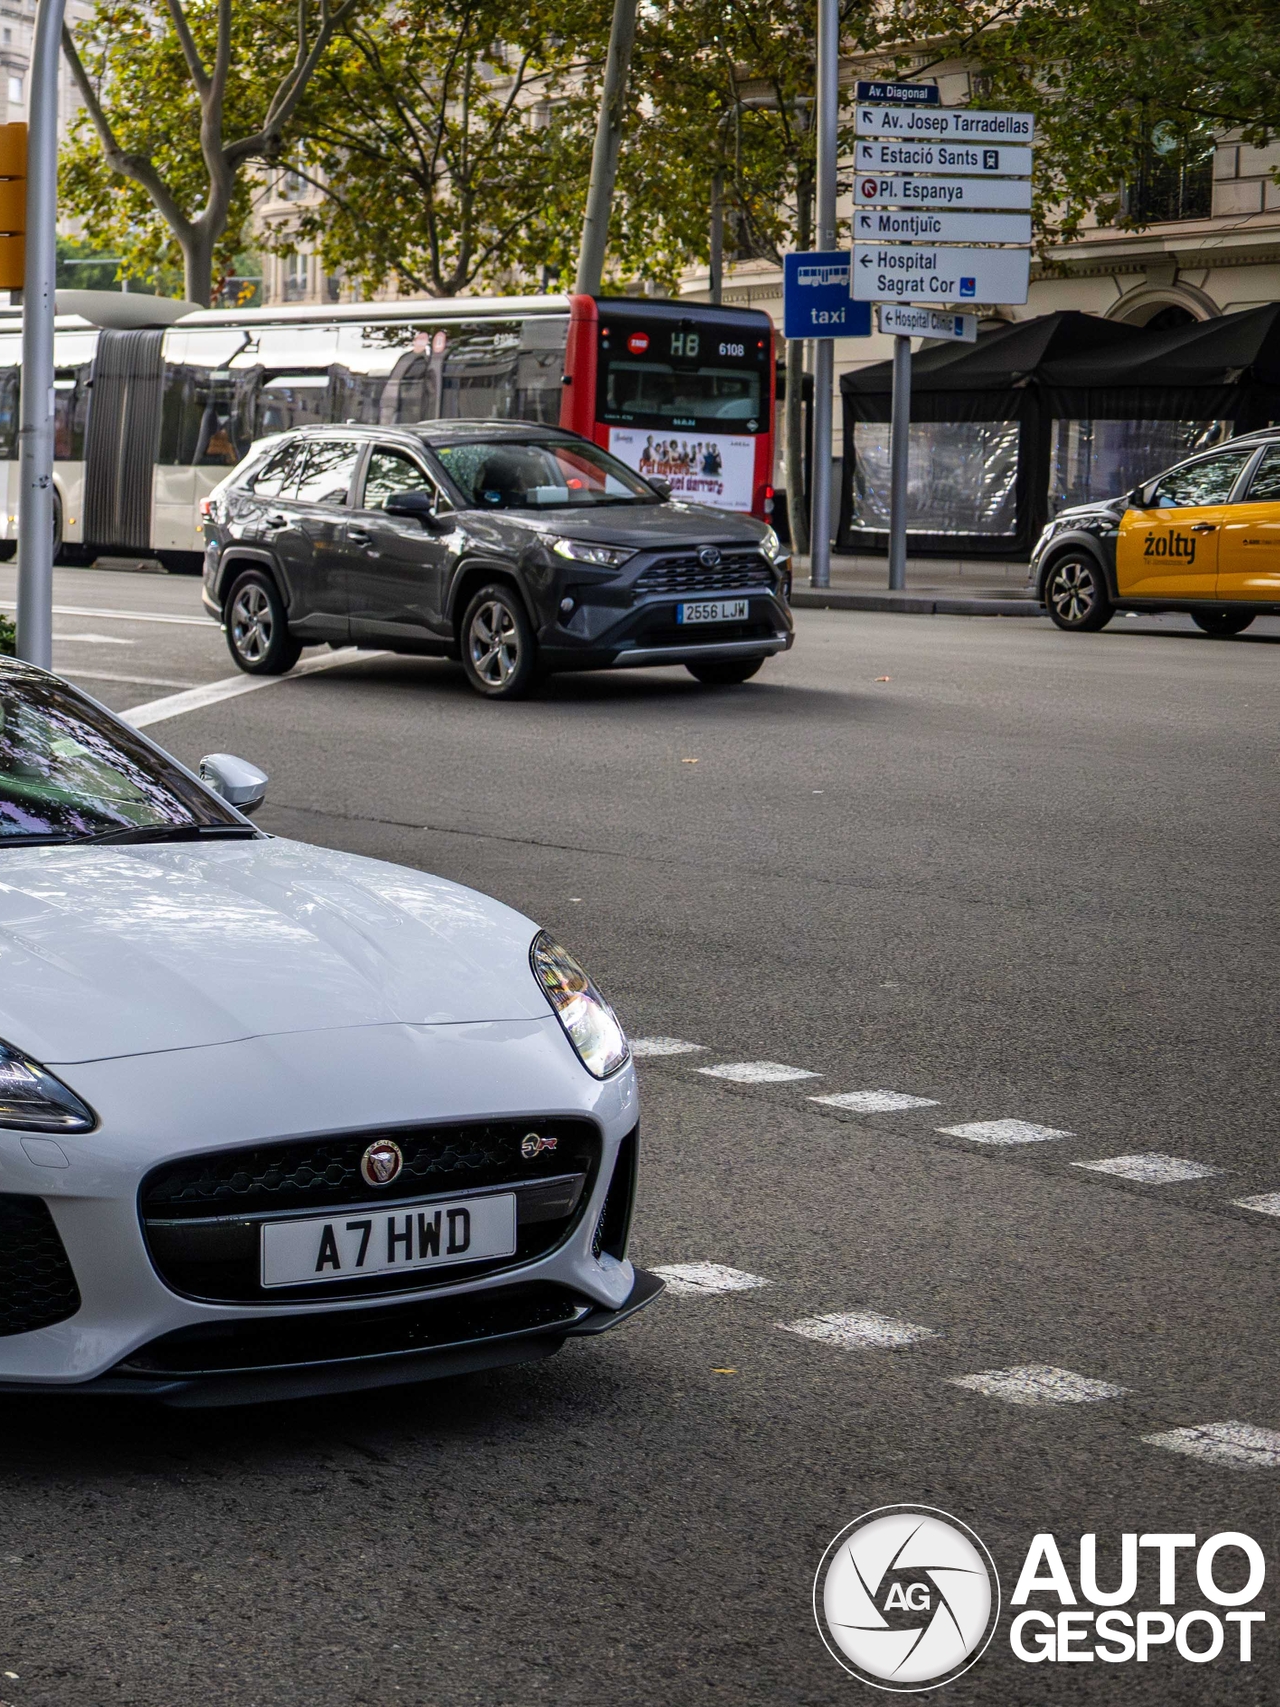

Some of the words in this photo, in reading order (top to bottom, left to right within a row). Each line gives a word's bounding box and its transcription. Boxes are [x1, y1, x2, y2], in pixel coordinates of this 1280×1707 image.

[869, 85, 884, 98] Av.
[886, 85, 928, 100] Diagonal
[881, 111, 903, 129] Av.
[907, 112, 949, 134] Josep
[953, 114, 1029, 135] Tarradellas
[880, 146, 933, 165] Estació
[938, 148, 978, 166] Sants
[879, 180, 898, 198] Pl.
[903, 181, 963, 202] Espanya
[878, 215, 942, 236] Montjuïc
[877, 251, 937, 271] Hospital
[877, 275, 924, 295] Sagrat
[929, 276, 955, 293] Cor
[811, 307, 846, 325] taxi
[895, 309, 929, 330] Hospital
[718, 342, 745, 357] 6108
[1143, 529, 1196, 565] żolty
[686, 604, 718, 620] 2556
[722, 602, 746, 618] LJW
[314, 1220, 373, 1273] A7
[387, 1207, 471, 1263] HWD
